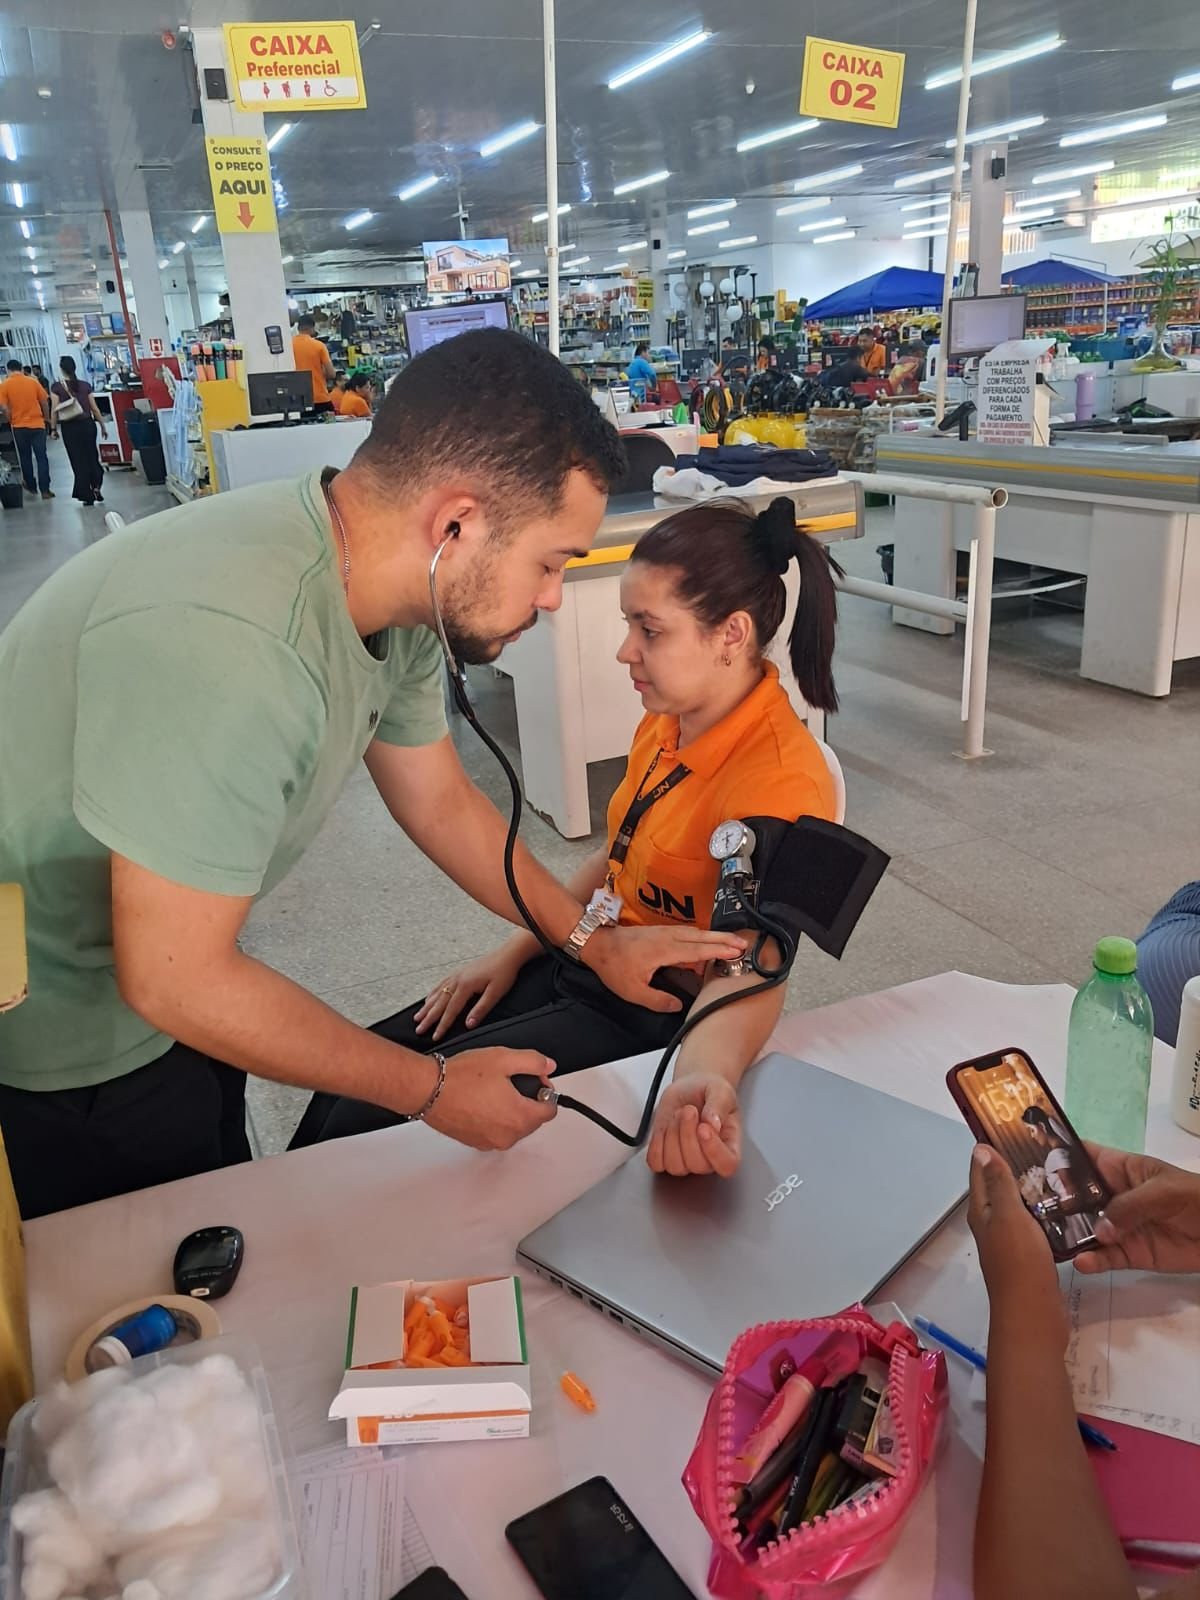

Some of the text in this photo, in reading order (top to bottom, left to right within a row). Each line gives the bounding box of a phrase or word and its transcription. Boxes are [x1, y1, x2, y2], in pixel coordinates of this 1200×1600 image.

[250, 35, 333, 56] CAIXA
[246, 60, 341, 77] Preferencial
[822, 52, 884, 79] CAIXA
[830, 79, 877, 111] 02
[212, 146, 262, 156] CONSULTE
[214, 162, 264, 173] O PREÇO
[219, 179, 267, 195] AQUI
[991, 368, 1023, 376] TRABALHA
[986, 376, 1026, 386] COM PREÇOS
[982, 386, 1030, 394] DIFERENCIADOS
[988, 395, 1022, 403] PARA CADA
[990, 404, 1020, 412] FORMA DE
[764, 1174, 804, 1212] acer
